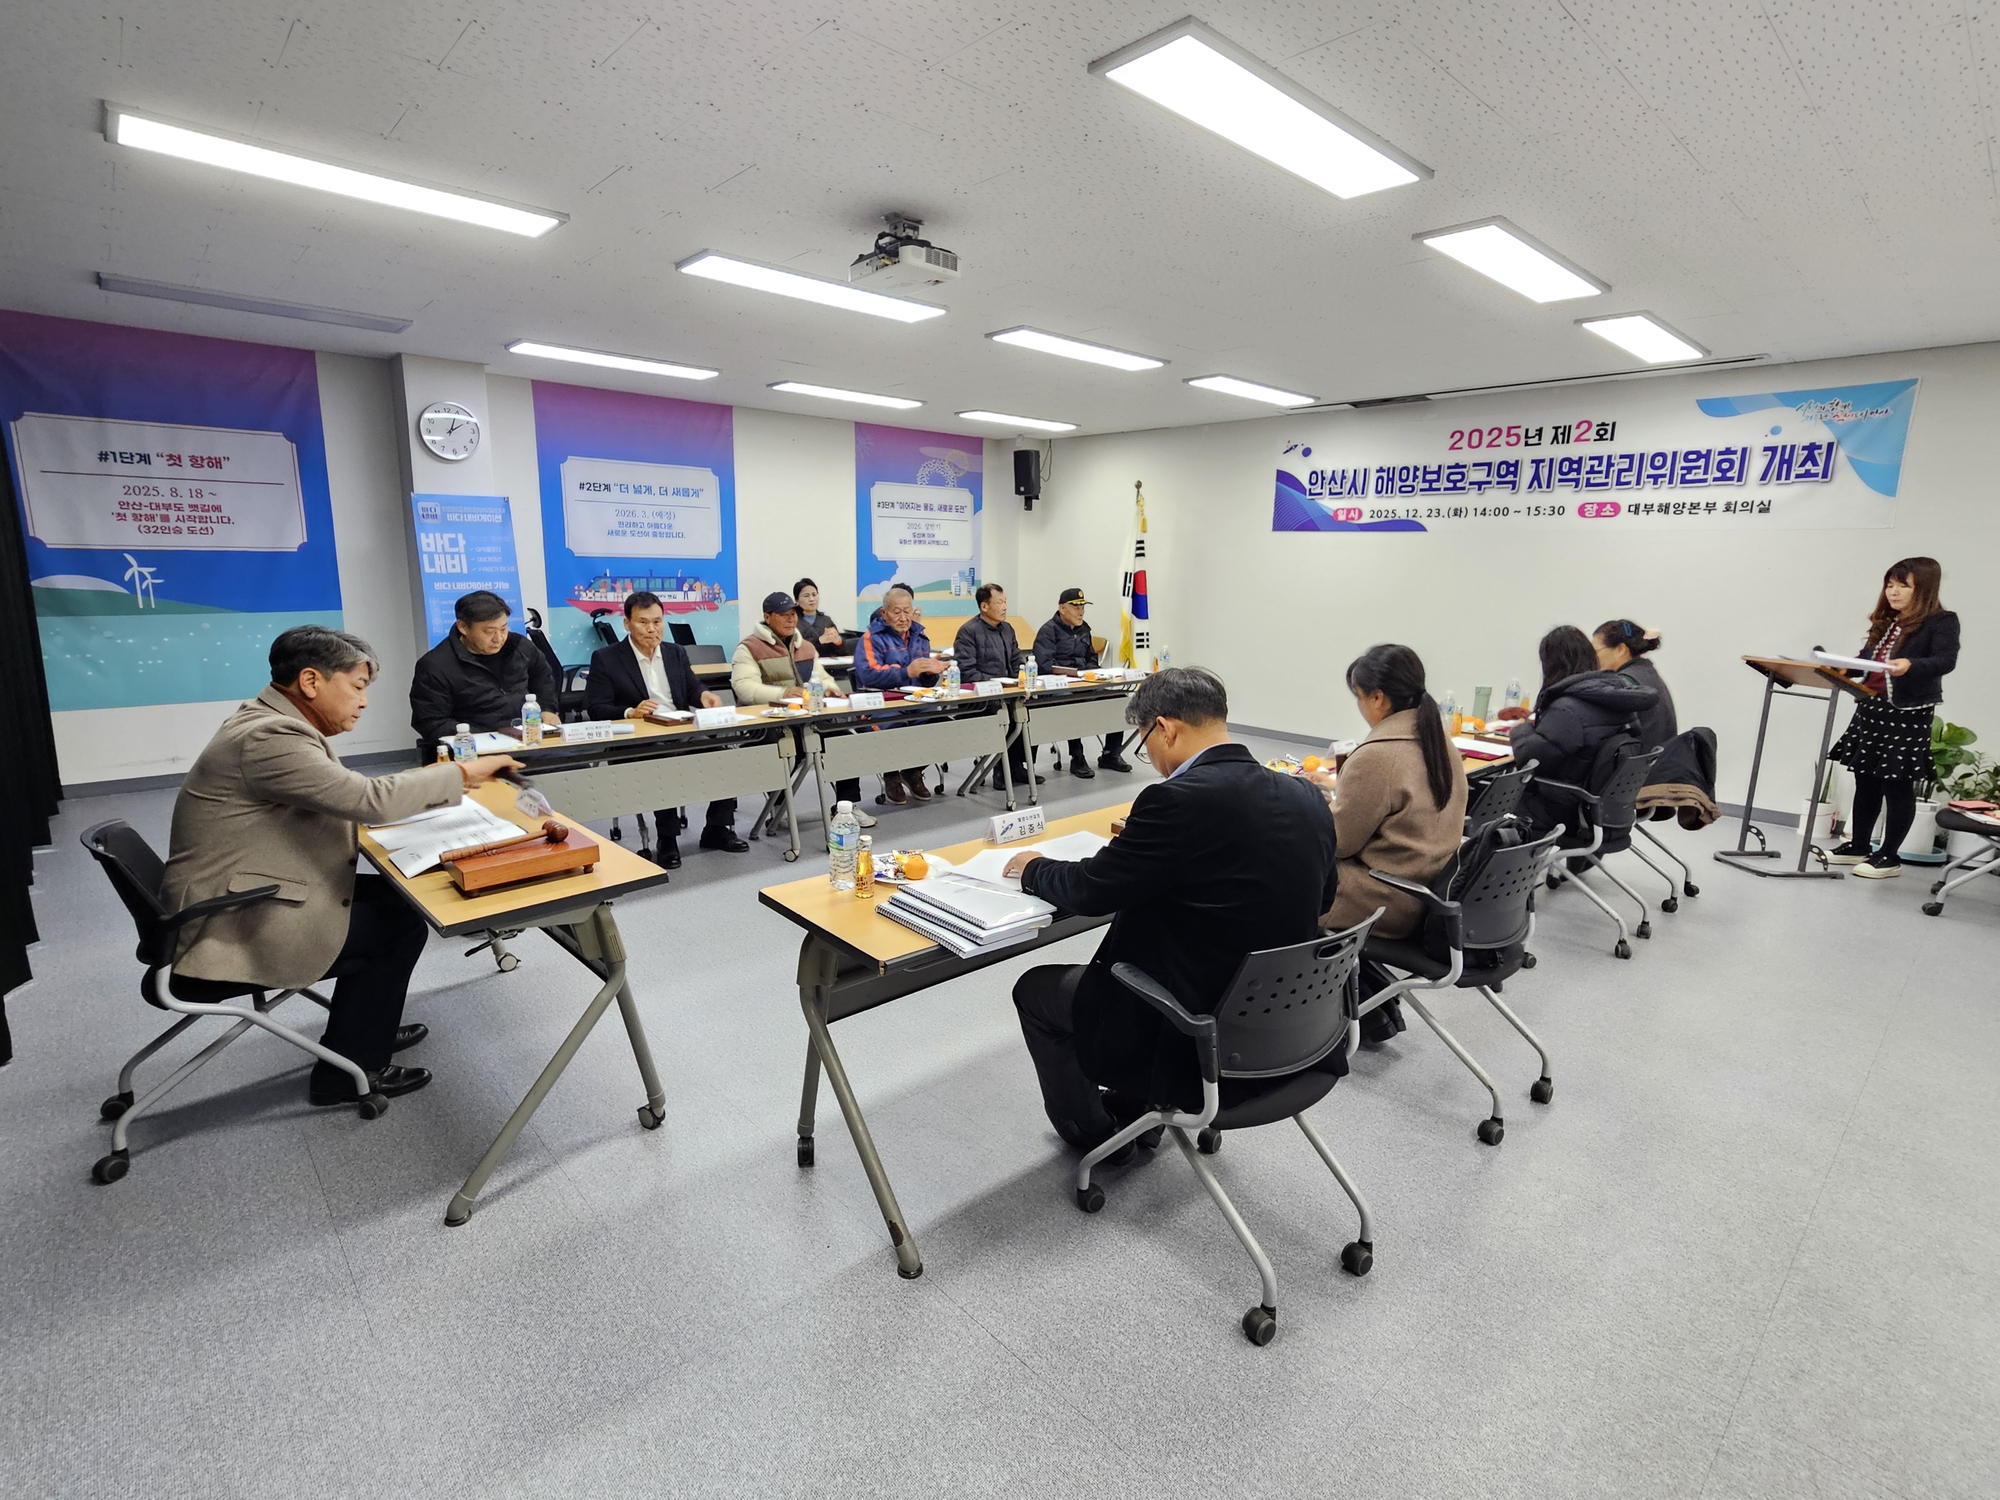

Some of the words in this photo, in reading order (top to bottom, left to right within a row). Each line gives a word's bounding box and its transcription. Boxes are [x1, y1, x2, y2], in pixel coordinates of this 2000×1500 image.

[1448, 424, 1543, 451] 2025년
[1550, 419, 1617, 446] 제2회
[97, 450, 151, 466] #1단계
[156, 451, 185, 468] “첫
[190, 454, 230, 470] 항해”
[1307, 466, 1369, 498] 안산시
[1373, 459, 1521, 495] 해양보호구역
[1526, 446, 1750, 490] 지역관리위원회
[1759, 441, 1835, 483] 개최
[123, 484, 164, 498] 2025.
[170, 486, 183, 499] 8.
[188, 487, 204, 499] 18
[579, 481, 611, 492] #2단계
[659, 486, 668, 496] 더
[118, 500, 185, 513] 안산-대부도
[188, 501, 222, 513] 뱃길에
[615, 509, 639, 519] 2026.
[642, 510, 649, 519] 3.
[1336, 508, 1360, 521] 일시
[1369, 508, 1402, 519] 2025.
[1405, 507, 1423, 519] 12.
[1473, 506, 1510, 518] 14:00
[1526, 505, 1566, 517] 15:30
[1583, 503, 1616, 517] 장소
[1628, 501, 1718, 515] 대부해양본부
[1722, 500, 1772, 514] 회의실
[175, 513, 235, 525] 시작합니다.
[137, 524, 183, 536] (32인승
[187, 525, 215, 536] 도선)
[420, 532, 466, 553] 바다
[423, 553, 468, 574] 내비
